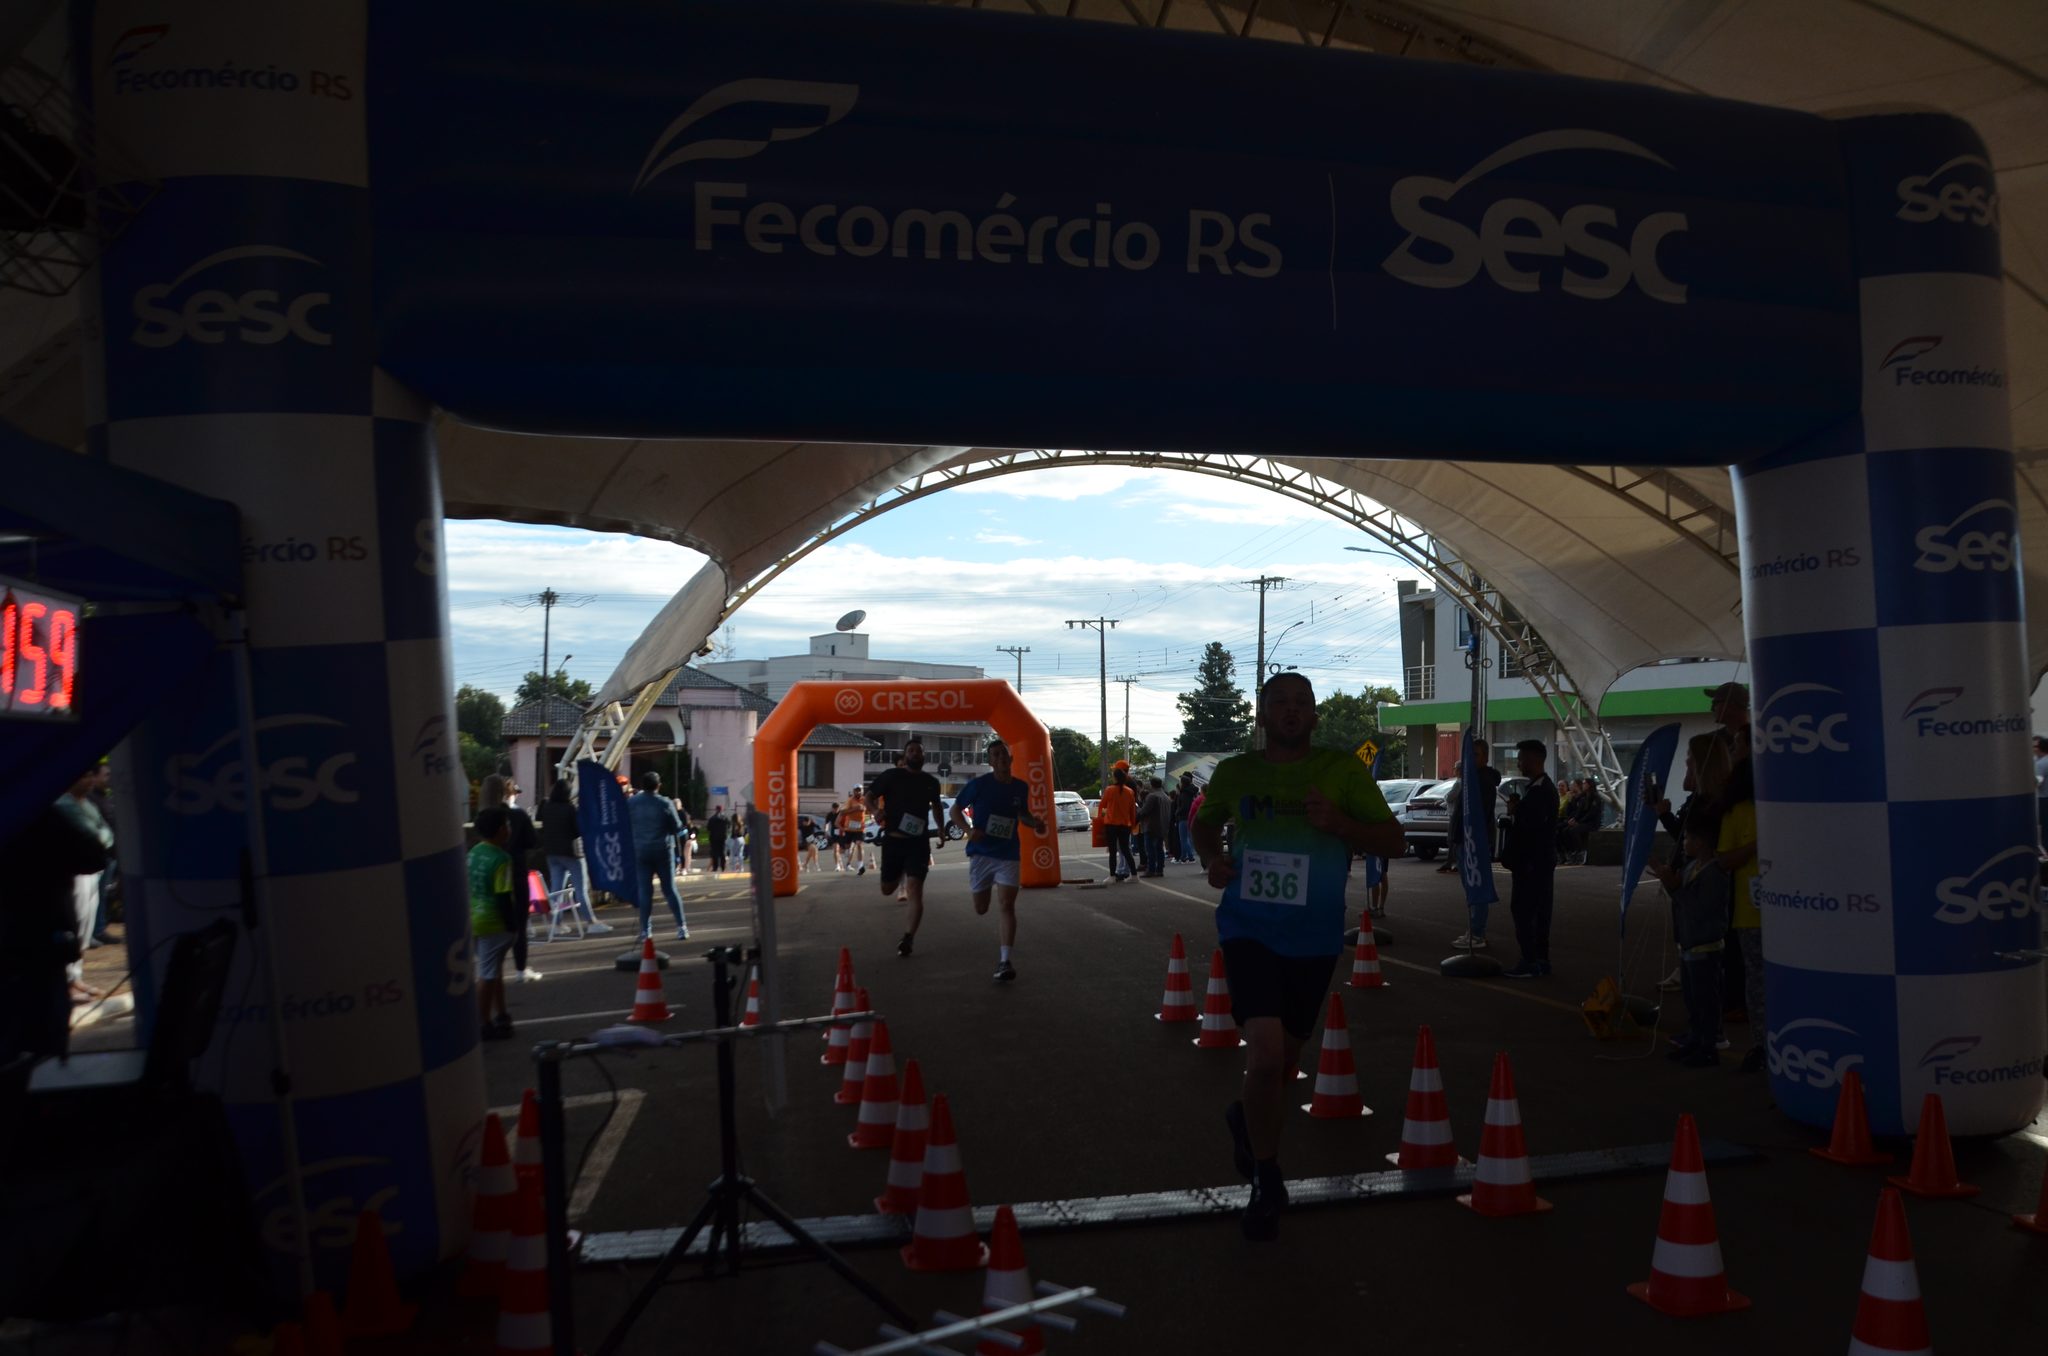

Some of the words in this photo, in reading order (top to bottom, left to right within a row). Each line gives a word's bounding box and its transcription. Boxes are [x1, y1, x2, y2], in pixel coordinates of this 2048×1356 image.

[116, 60, 299, 95] Fecomércio
[309, 70, 353, 101] RS
[694, 181, 1161, 271] Fecomércio
[1186, 209, 1284, 279] RS
[1380, 175, 1689, 304] Sesc
[130, 282, 333, 348] Sesc
[327, 536, 368, 561] RS
[1827, 547, 1862, 568] RS
[871, 689, 974, 711] CRESOL
[767, 764, 787, 850] CRESOL
[1028, 754, 1050, 839] CRESOL
[604, 832, 624, 881] Sesc
[1249, 869, 1299, 901] 336
[1847, 893, 1881, 913] RS
[363, 979, 404, 1008] RS
